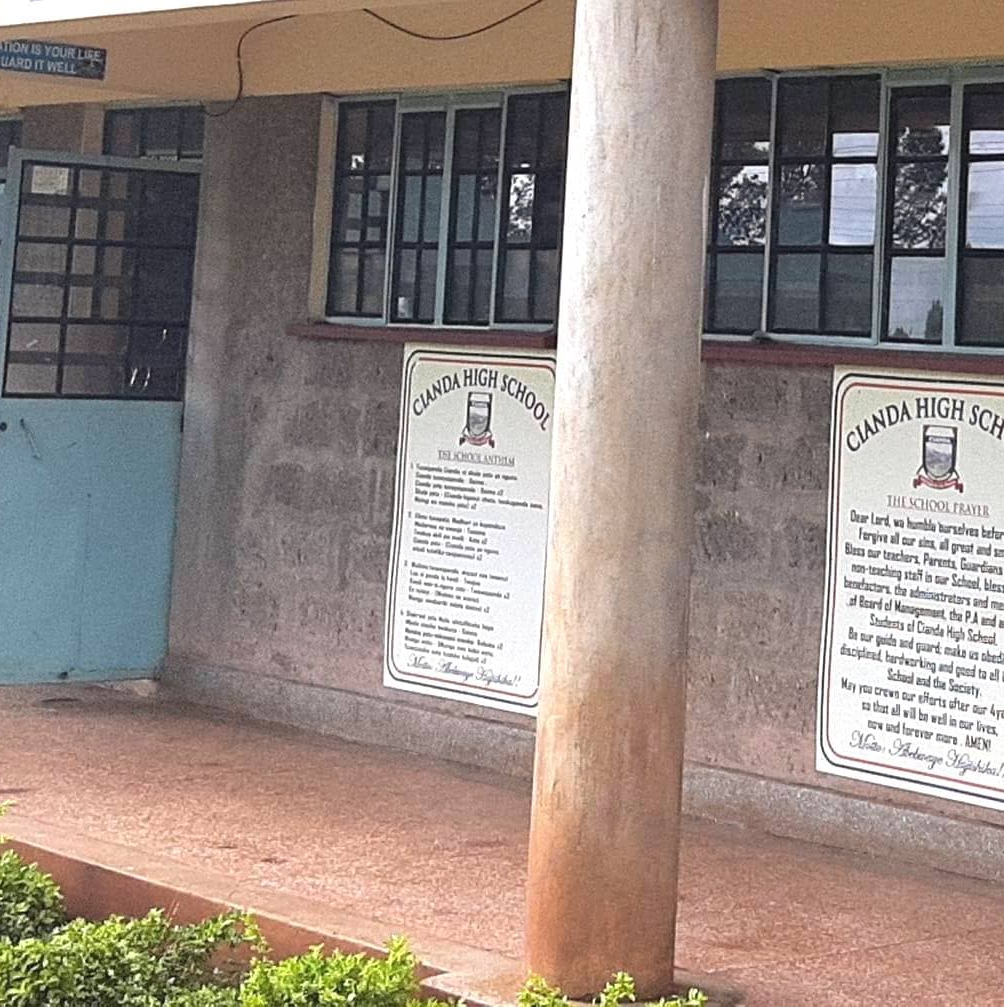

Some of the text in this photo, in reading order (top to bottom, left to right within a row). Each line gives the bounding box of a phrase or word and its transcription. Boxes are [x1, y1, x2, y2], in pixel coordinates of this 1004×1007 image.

[31, 44, 41, 56] IS
[45, 45, 76, 59] YOUR
[78, 49, 101, 61] LIFE
[35, 60, 44, 71] IT
[47, 61, 76, 74] WELL
[413, 369, 550, 431] CIANDA HIGH SCHOOL
[846, 400, 912, 451] CIANDA
[915, 397, 965, 421] HIGH
[887, 495, 989, 517] THE SCHOOL PRAYER
[850, 509, 868, 523] Dear
[868, 548, 881, 559] our
[890, 532, 899, 544] all
[951, 543, 973, 554] great
[976, 544, 991, 556] and
[859, 595, 882, 610] Board
[973, 596, 988, 609] and
[917, 620, 944, 637] Cianda
[947, 625, 965, 642] High
[887, 668, 914, 685] School
[933, 676, 946, 690] the
[841, 677, 856, 693] May
[859, 683, 872, 694] you
[949, 697, 970, 712] after
[891, 704, 900, 716] all
[903, 707, 916, 720] will
